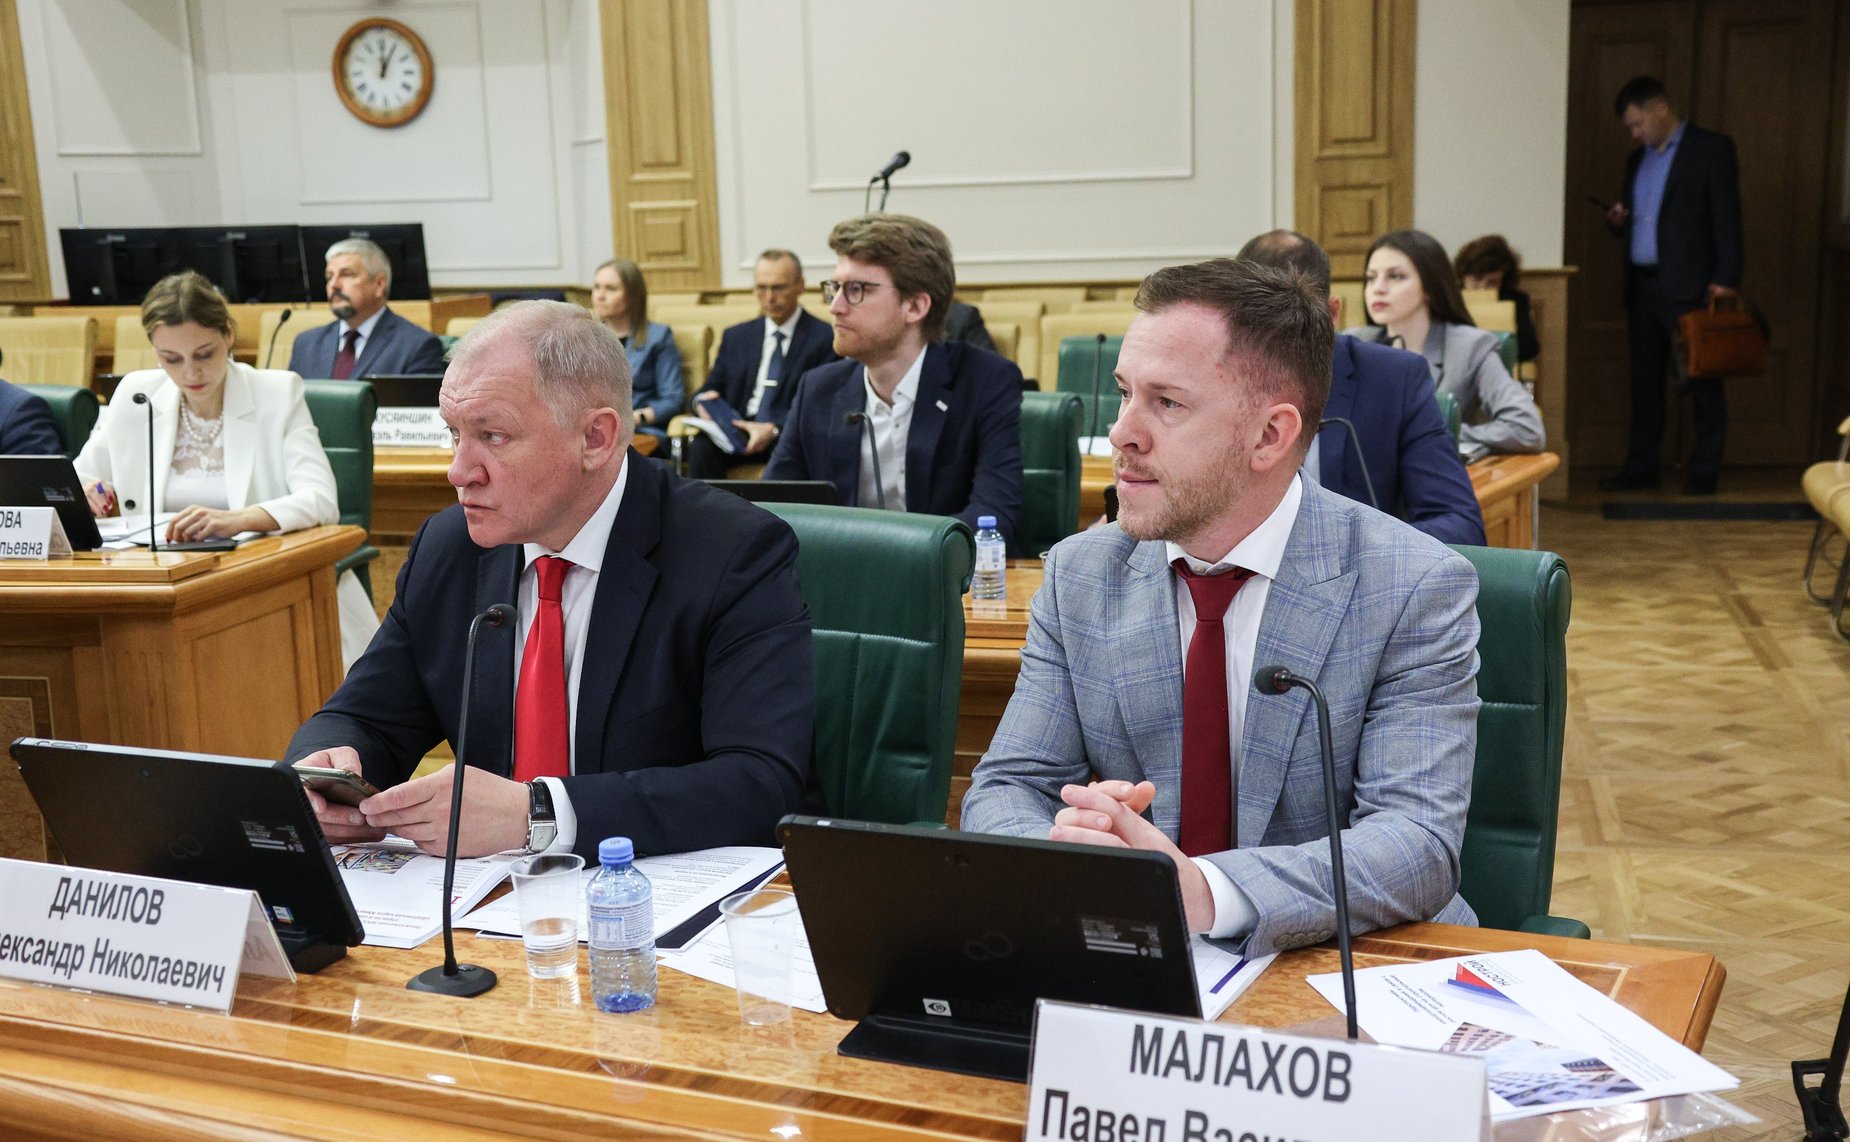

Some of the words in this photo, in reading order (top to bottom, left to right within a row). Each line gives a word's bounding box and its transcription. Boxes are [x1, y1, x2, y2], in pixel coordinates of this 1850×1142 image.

[48, 877, 165, 926] ДАНИЛОВ
[0, 933, 85, 980] ександр
[89, 937, 226, 993] Николаевич
[1130, 1024, 1353, 1103] МАЛАХОВ
